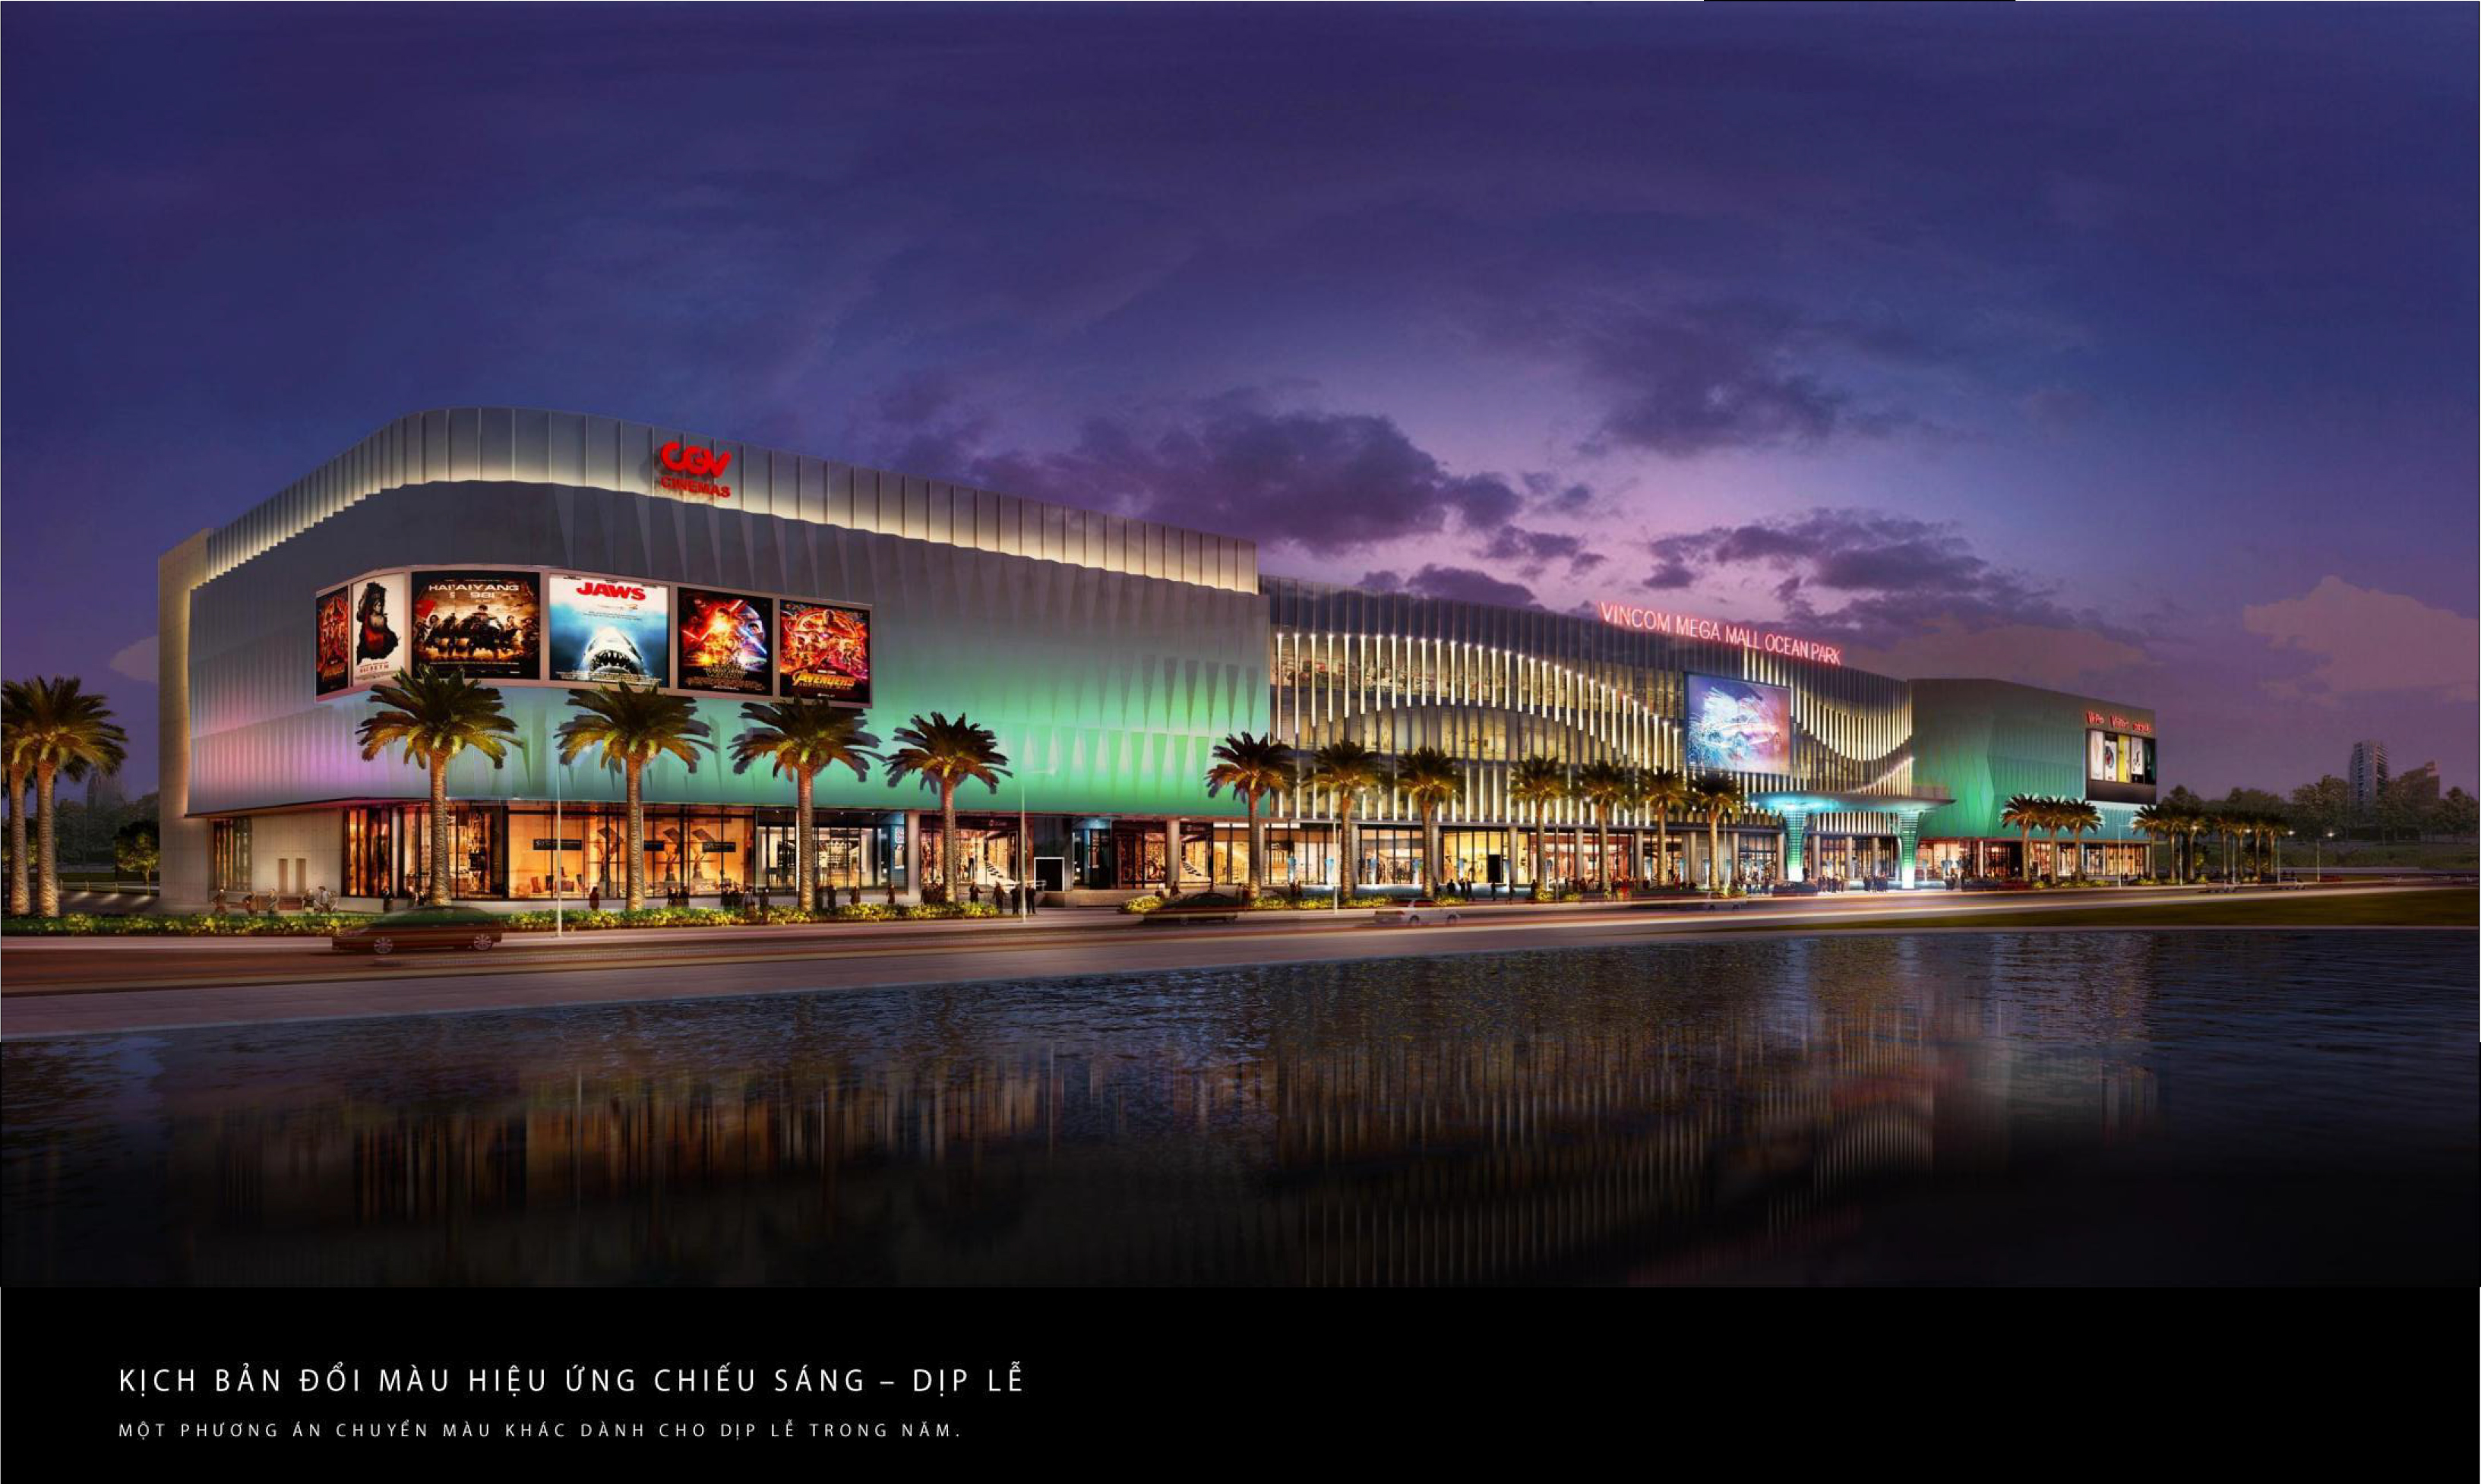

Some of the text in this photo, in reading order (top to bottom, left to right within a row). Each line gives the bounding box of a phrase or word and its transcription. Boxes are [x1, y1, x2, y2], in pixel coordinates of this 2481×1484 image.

[660, 441, 732, 478] CGV
[661, 476, 731, 498] CINEMAS
[576, 582, 646, 601] JAWS
[1598, 601, 1841, 666] VINCOM MEGA MALL OCEAN PARK
